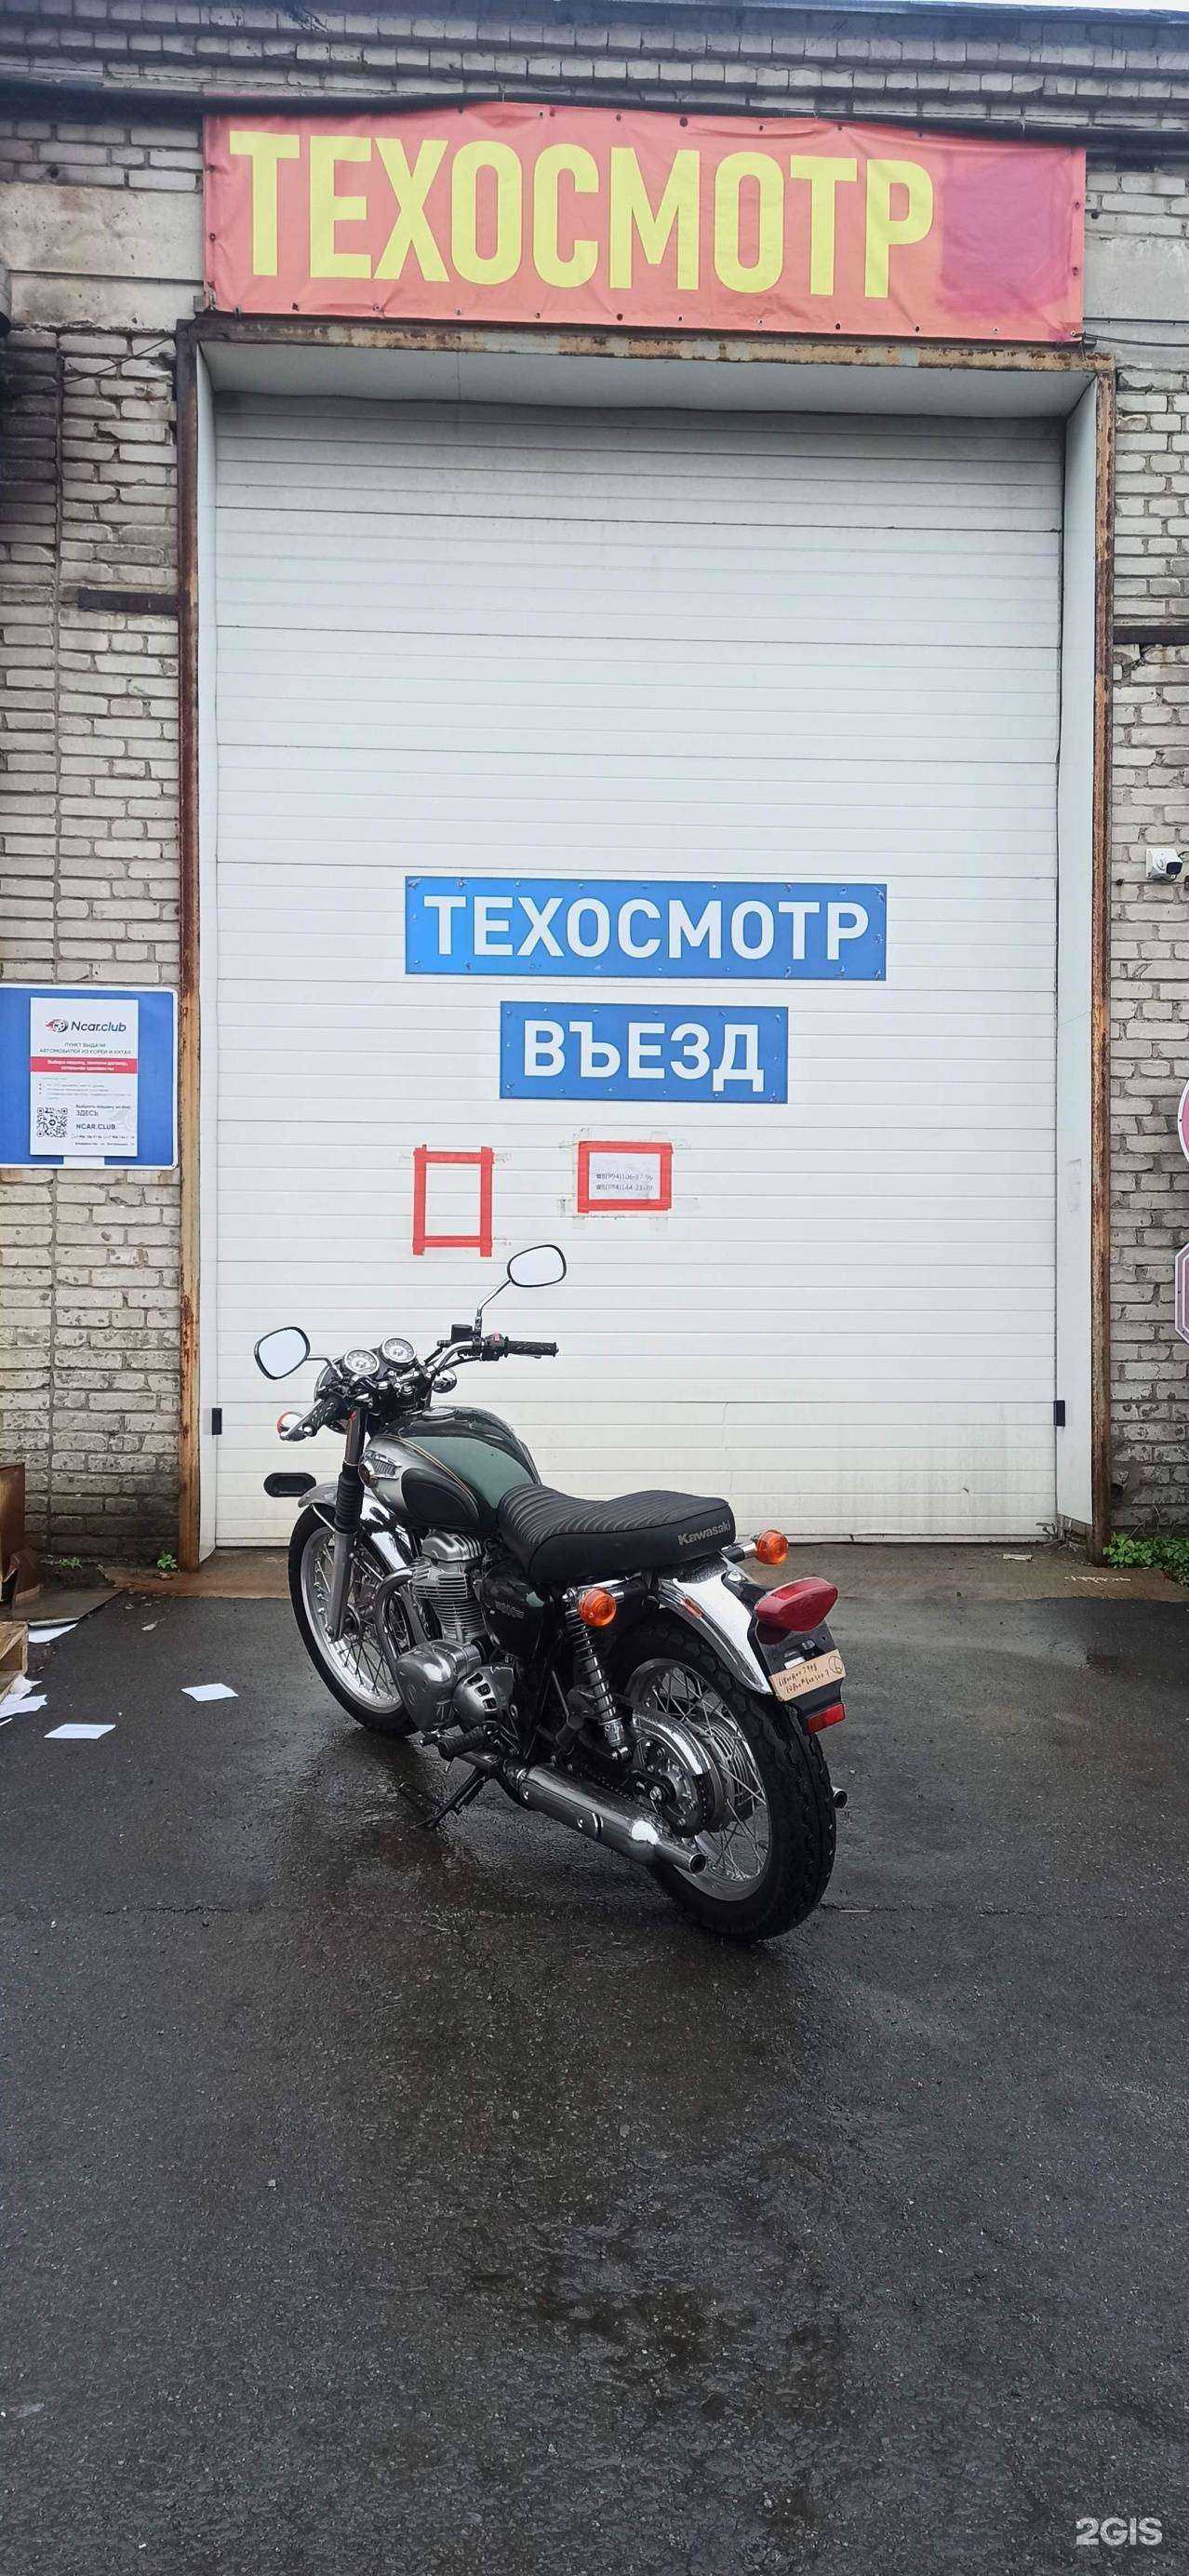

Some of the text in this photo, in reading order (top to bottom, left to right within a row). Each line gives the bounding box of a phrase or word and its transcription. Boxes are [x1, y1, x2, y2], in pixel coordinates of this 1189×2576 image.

[229, 130, 934, 298] ТЕХОСМОТР
[423, 895, 870, 960] ТЕХОСМОТР
[71, 1021, 127, 1032] Ncar.club
[523, 1019, 765, 1092] ВЪЕЗД
[677, 1520, 731, 1546] Kawasaki
